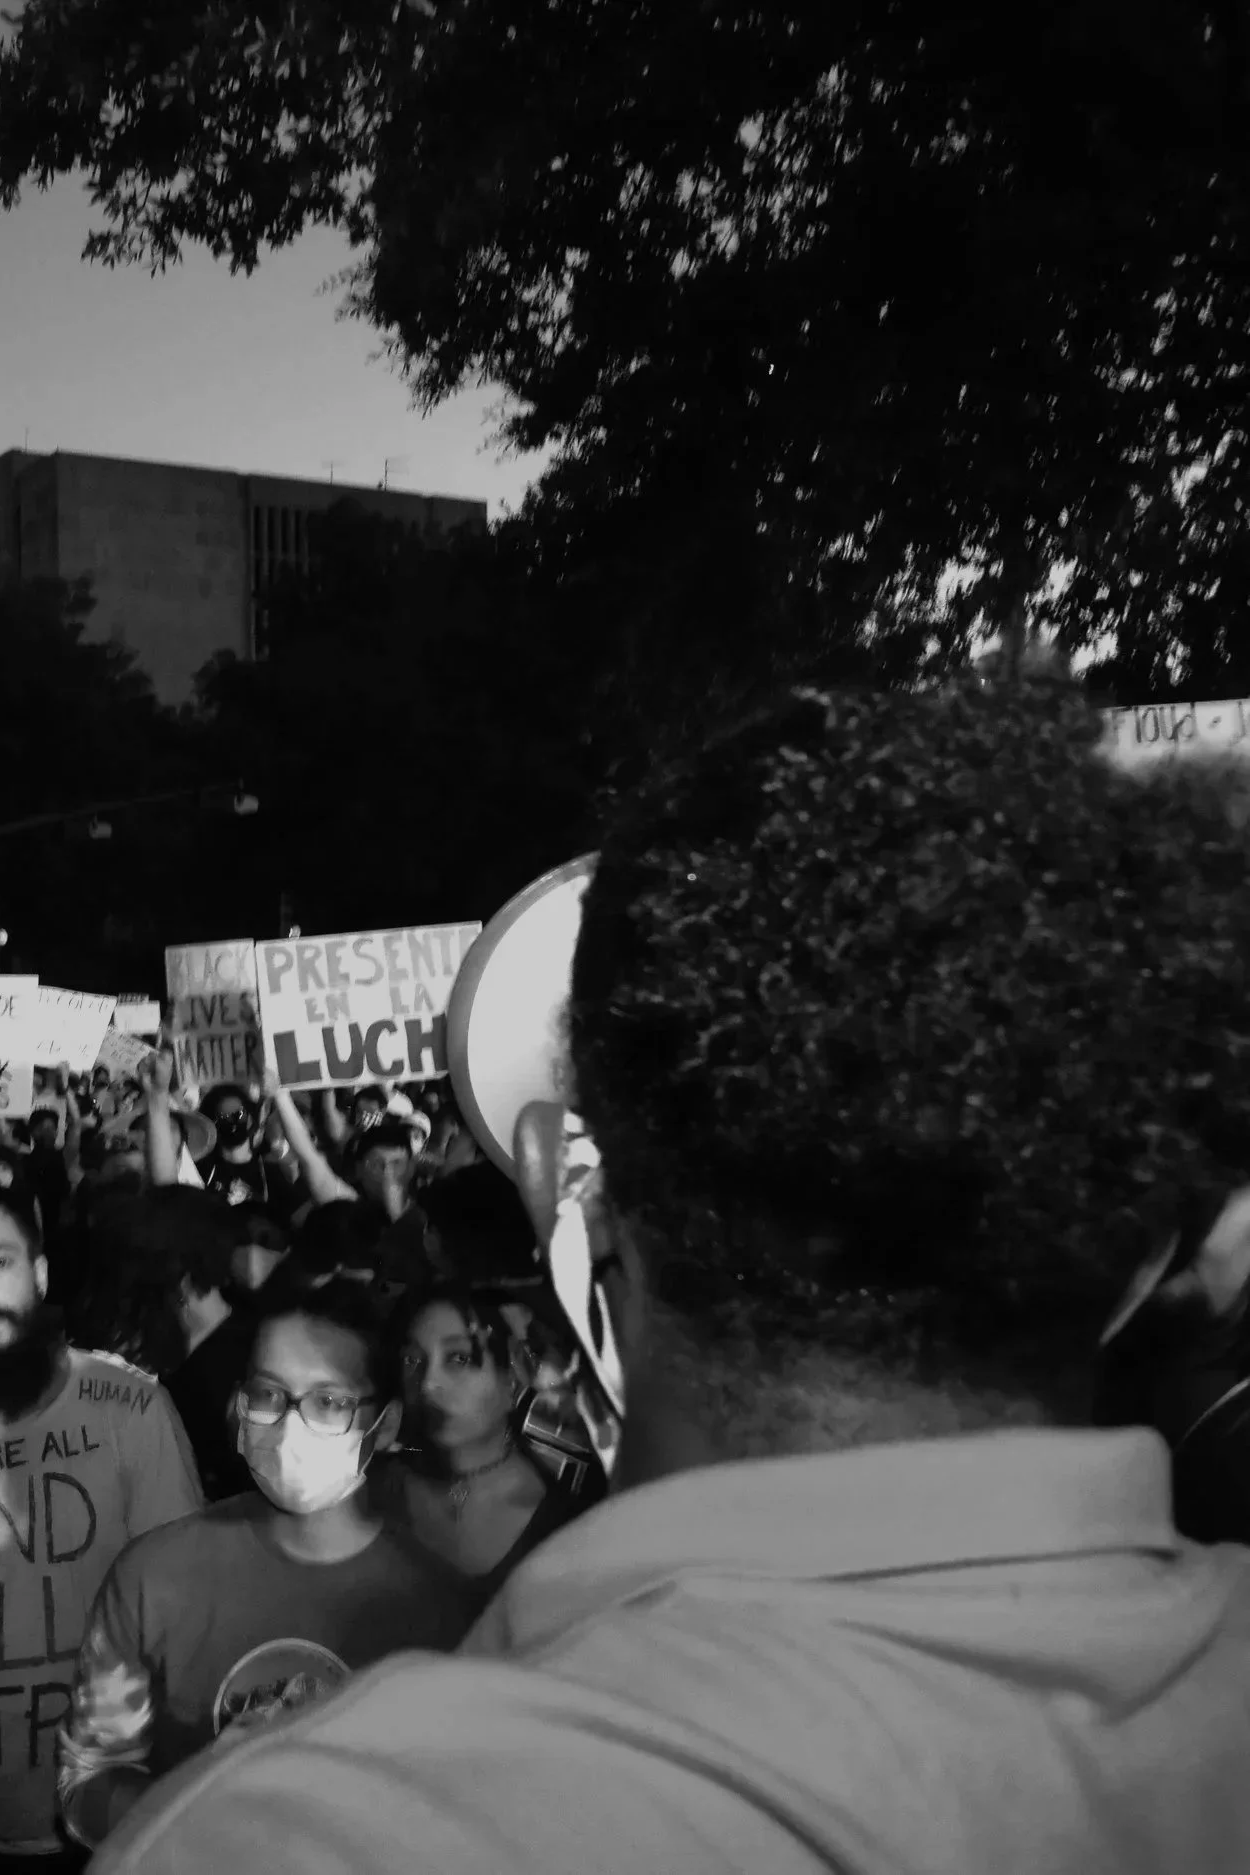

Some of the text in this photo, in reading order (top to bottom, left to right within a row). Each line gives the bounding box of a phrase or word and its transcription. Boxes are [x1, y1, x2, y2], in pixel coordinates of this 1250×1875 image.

[304, 983, 435, 1023] EN LA
[78, 1378, 152, 1416] HUMAN
[40, 1425, 100, 1461] ALL
